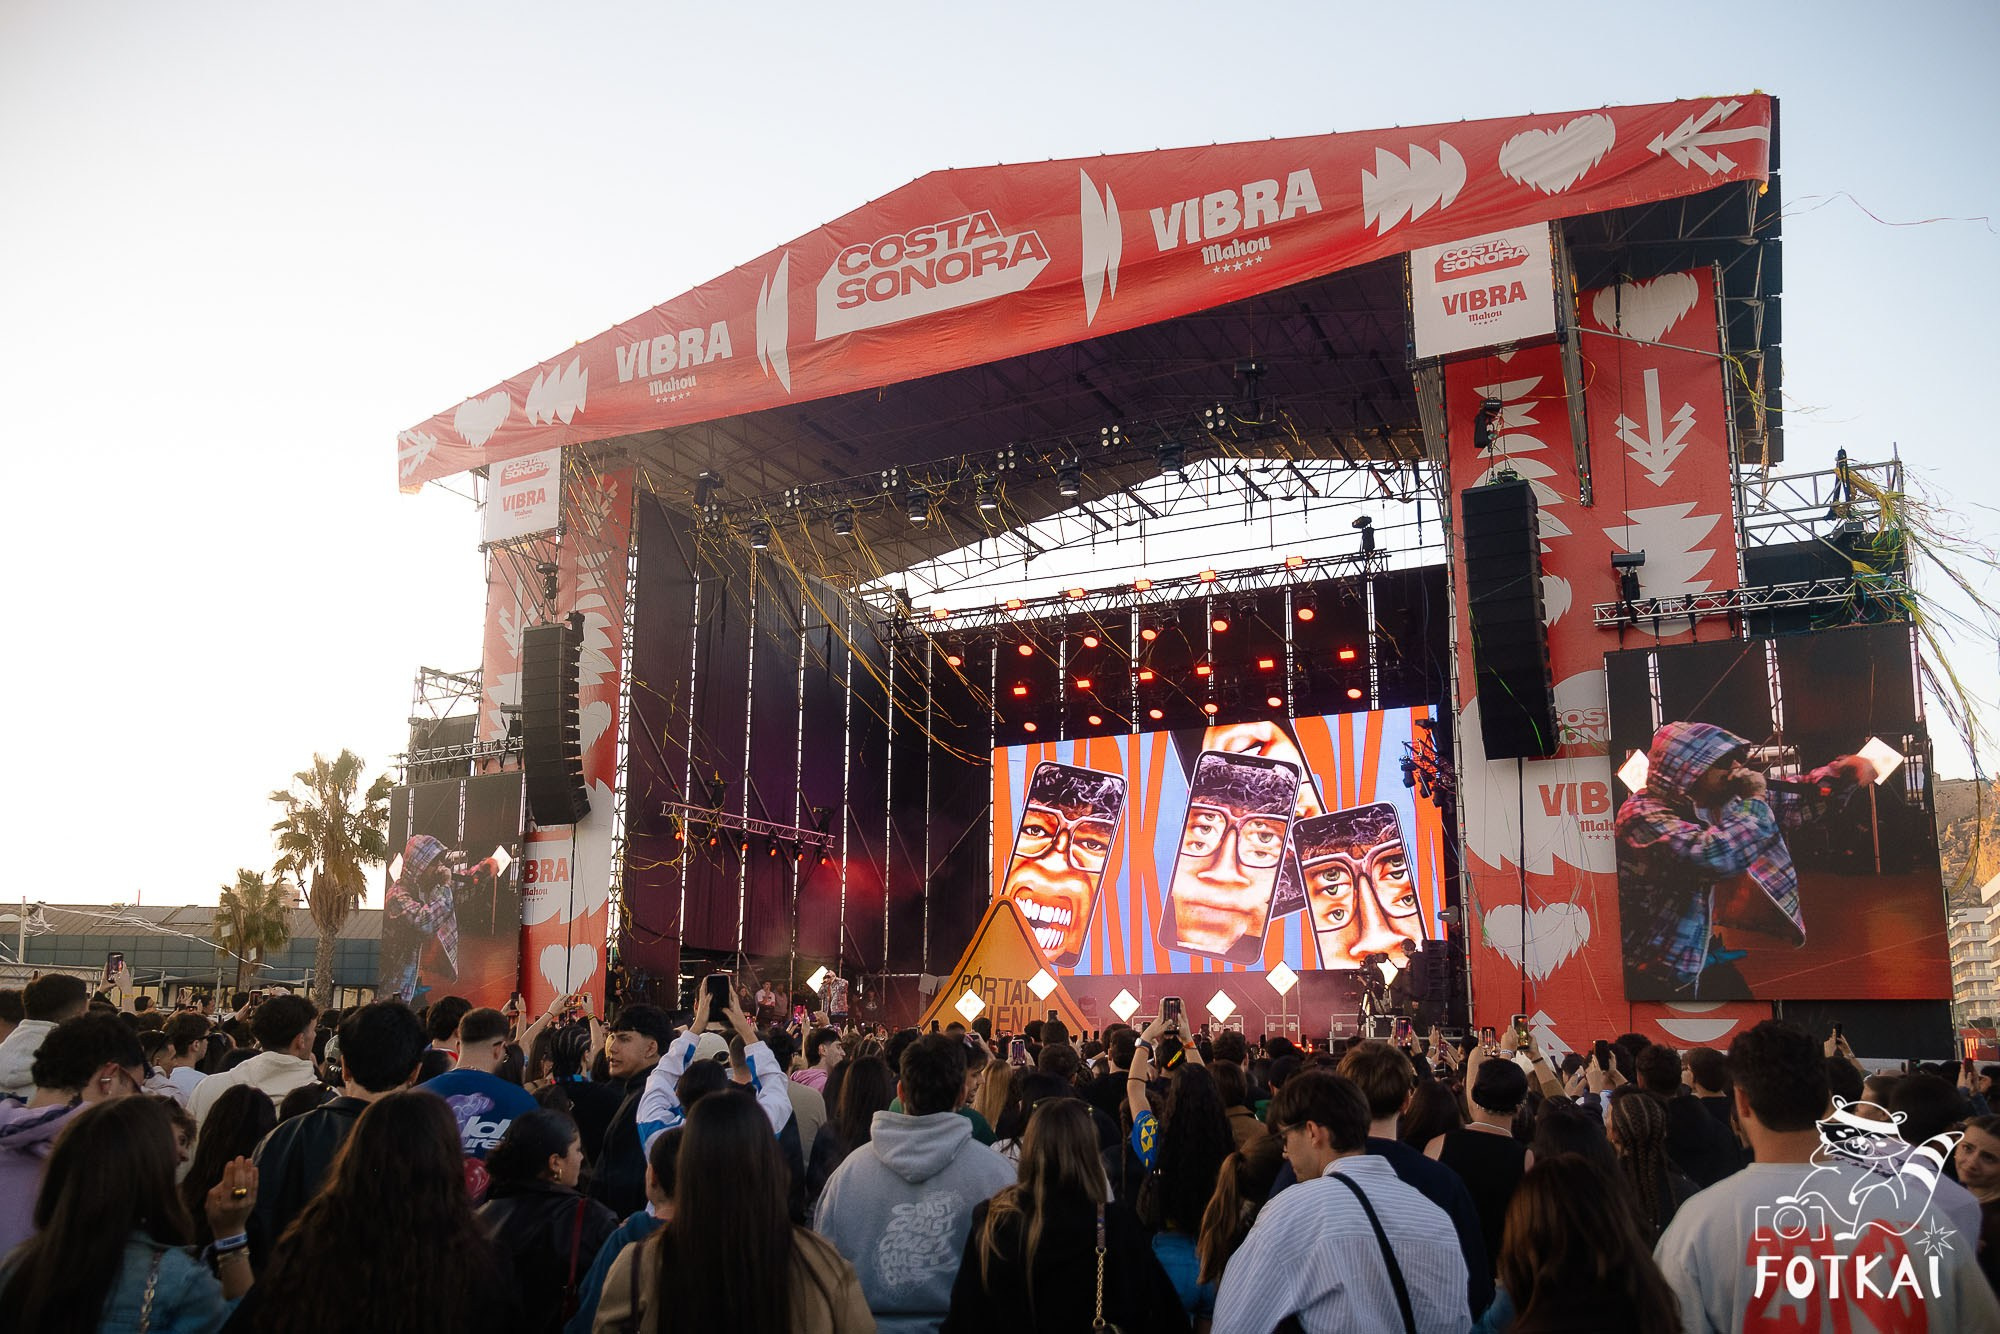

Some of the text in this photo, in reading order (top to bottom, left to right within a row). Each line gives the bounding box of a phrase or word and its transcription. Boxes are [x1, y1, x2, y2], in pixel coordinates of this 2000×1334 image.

[1149, 168, 1323, 252] VIBRA
[837, 211, 1001, 276] COSTA
[1201, 236, 1272, 265] Mahou
[1442, 238, 1511, 261] COSTA
[836, 232, 1049, 310] SONORA
[1442, 245, 1529, 273] SONORA
[1442, 281, 1527, 316] VIBRA
[1468, 310, 1502, 322] Mahou
[615, 320, 733, 383] VIBRA
[648, 375, 697, 396] Mahou
[502, 487, 546, 512] VIBRA
[1538, 781, 1611, 817] VIB
[1580, 818, 1615, 833] Mah
[523, 857, 569, 884] BRA
[959, 966, 1040, 1006] PÓRTAT
